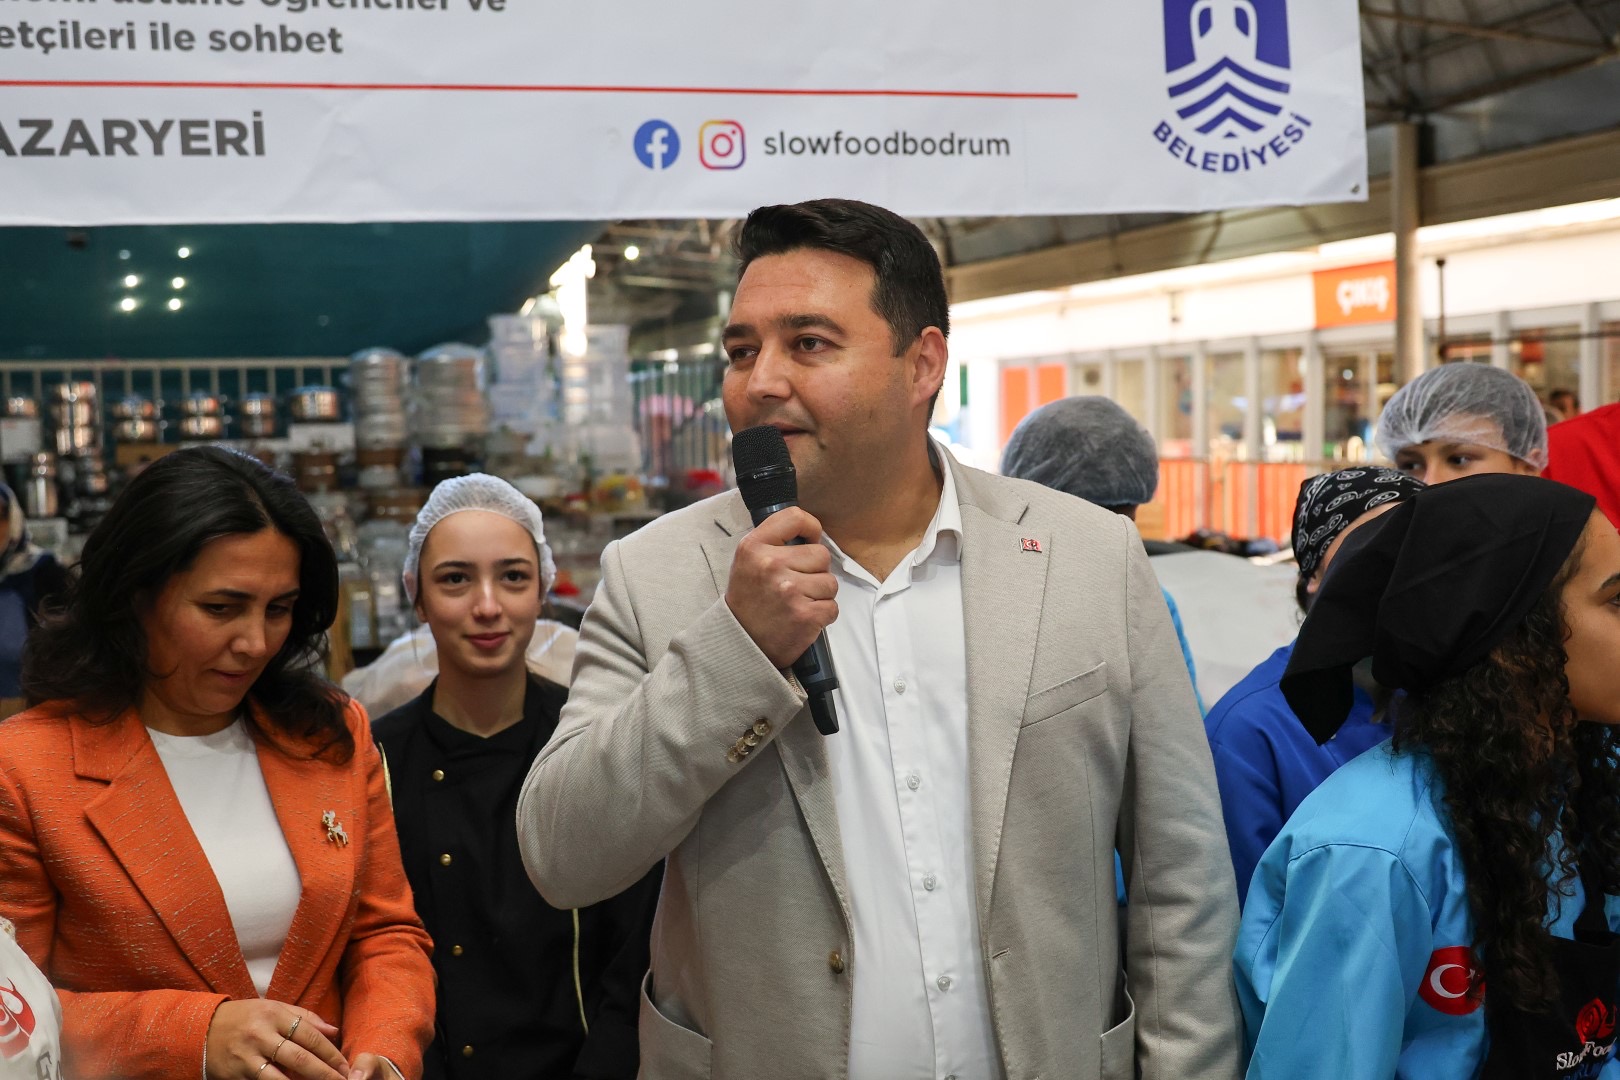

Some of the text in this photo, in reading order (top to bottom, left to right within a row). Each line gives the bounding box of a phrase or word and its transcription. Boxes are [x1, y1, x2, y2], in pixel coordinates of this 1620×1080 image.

[149, 22, 196, 51] ile
[208, 24, 343, 54] sohbet
[764, 131, 1010, 156] slowfoodbodrum
[1153, 112, 1312, 172] BELEDİYESİ
